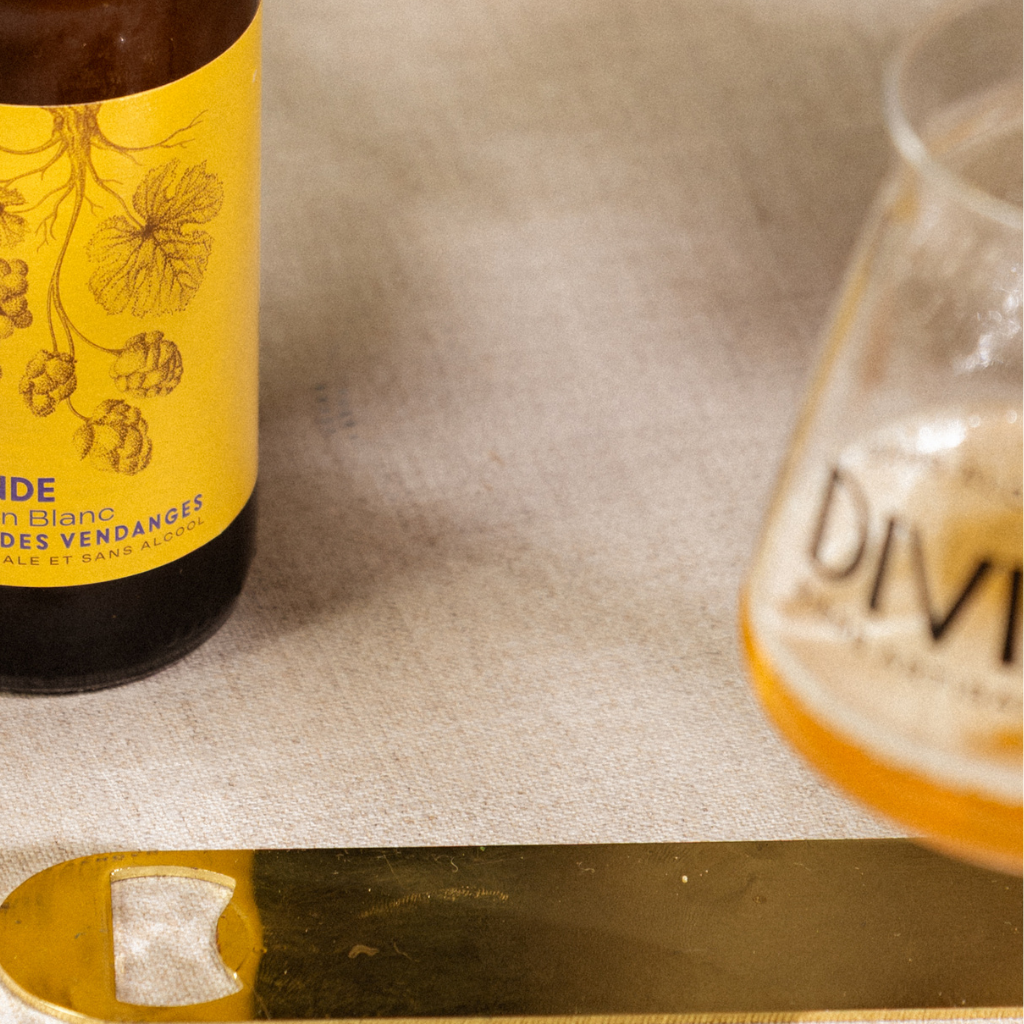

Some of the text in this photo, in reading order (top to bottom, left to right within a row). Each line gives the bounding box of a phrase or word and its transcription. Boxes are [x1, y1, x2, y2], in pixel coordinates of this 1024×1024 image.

[0, 532, 49, 551] DES
[60, 493, 204, 549] VENDANGES
[29, 507, 115, 527] Blanc
[49, 555, 73, 566] ET
[81, 545, 133, 563] SANS
[141, 517, 205, 551] ALCOOL
[808, 465, 1024, 668] DIVI
